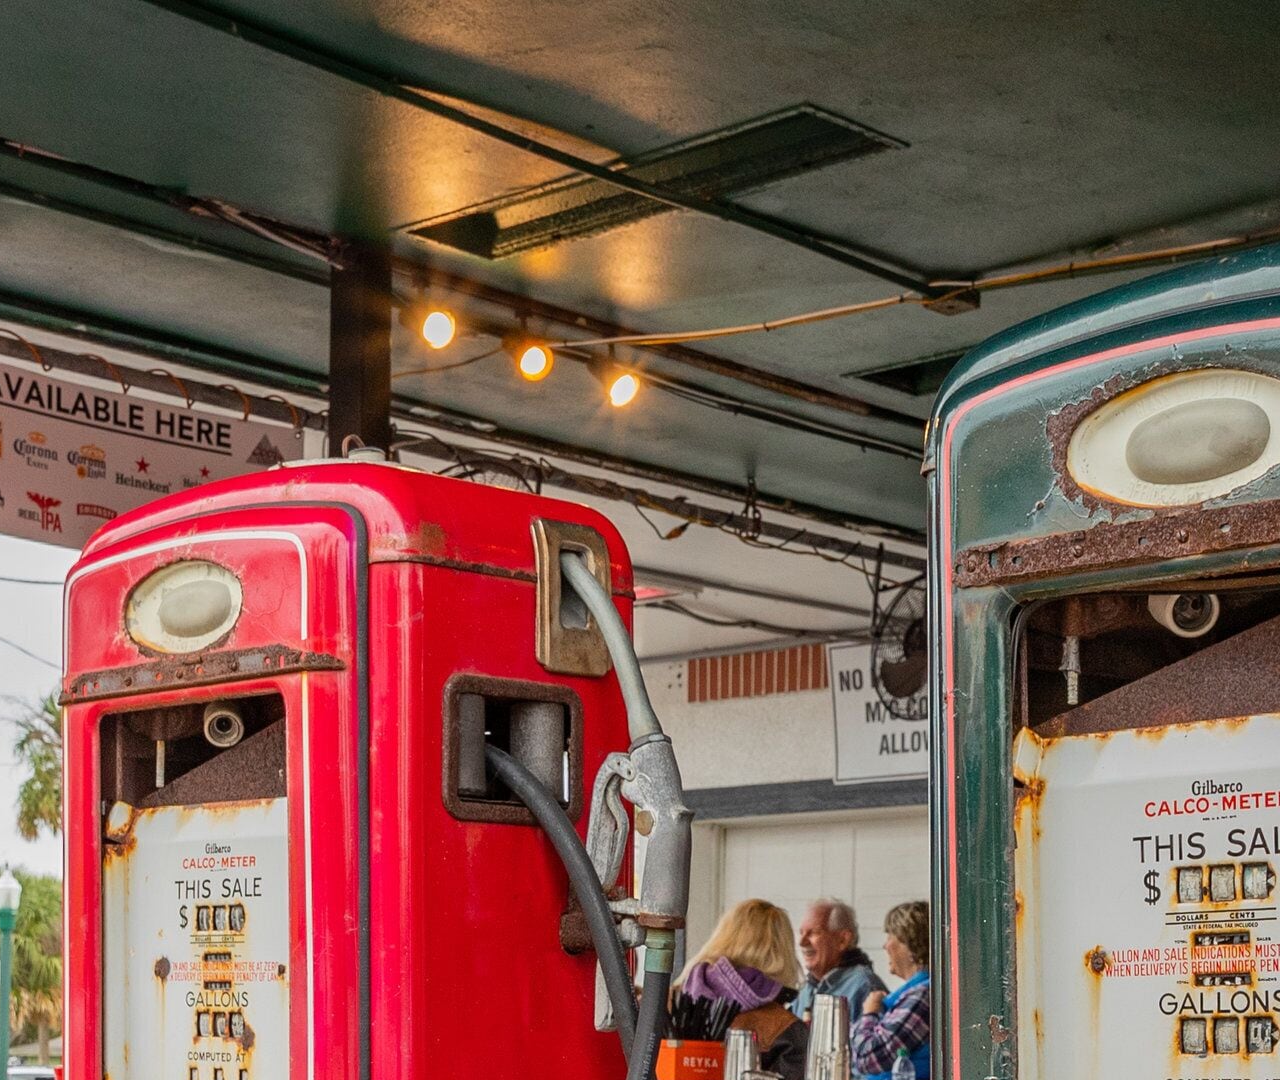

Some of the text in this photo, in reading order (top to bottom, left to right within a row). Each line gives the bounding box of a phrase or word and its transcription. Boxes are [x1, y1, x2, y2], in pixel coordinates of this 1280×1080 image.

[156, 410, 232, 449] HERE
[14, 438, 58, 461] Corona
[67, 451, 106, 470] Corona
[115, 473, 170, 493] Heineken
[40, 509, 62, 533] IPA
[839, 669, 863, 692] NO
[1192, 780, 1243, 795] Gilbarco
[205, 843, 231, 854] Gilbarco
[1133, 832, 1206, 863] THIS
[183, 856, 256, 869] CALCO-METER
[175, 877, 262, 899] THIS SALE
[1144, 869, 1161, 906] $
[1111, 949, 1139, 963] ALLON
[1142, 948, 1160, 961] AND
[1164, 947, 1187, 961] SALE
[1191, 944, 1251, 960] INDICATIONS
[1105, 965, 1131, 977] WHEN
[1134, 962, 1176, 976] DELIVERY
[1179, 962, 1188, 975] IS
[1191, 961, 1221, 974] BEGUN
[1225, 959, 1256, 973] UNDER
[186, 991, 249, 1007] GALLONS
[187, 1052, 246, 1062] COMPUTED AT
[682, 1056, 719, 1068] REYKA
